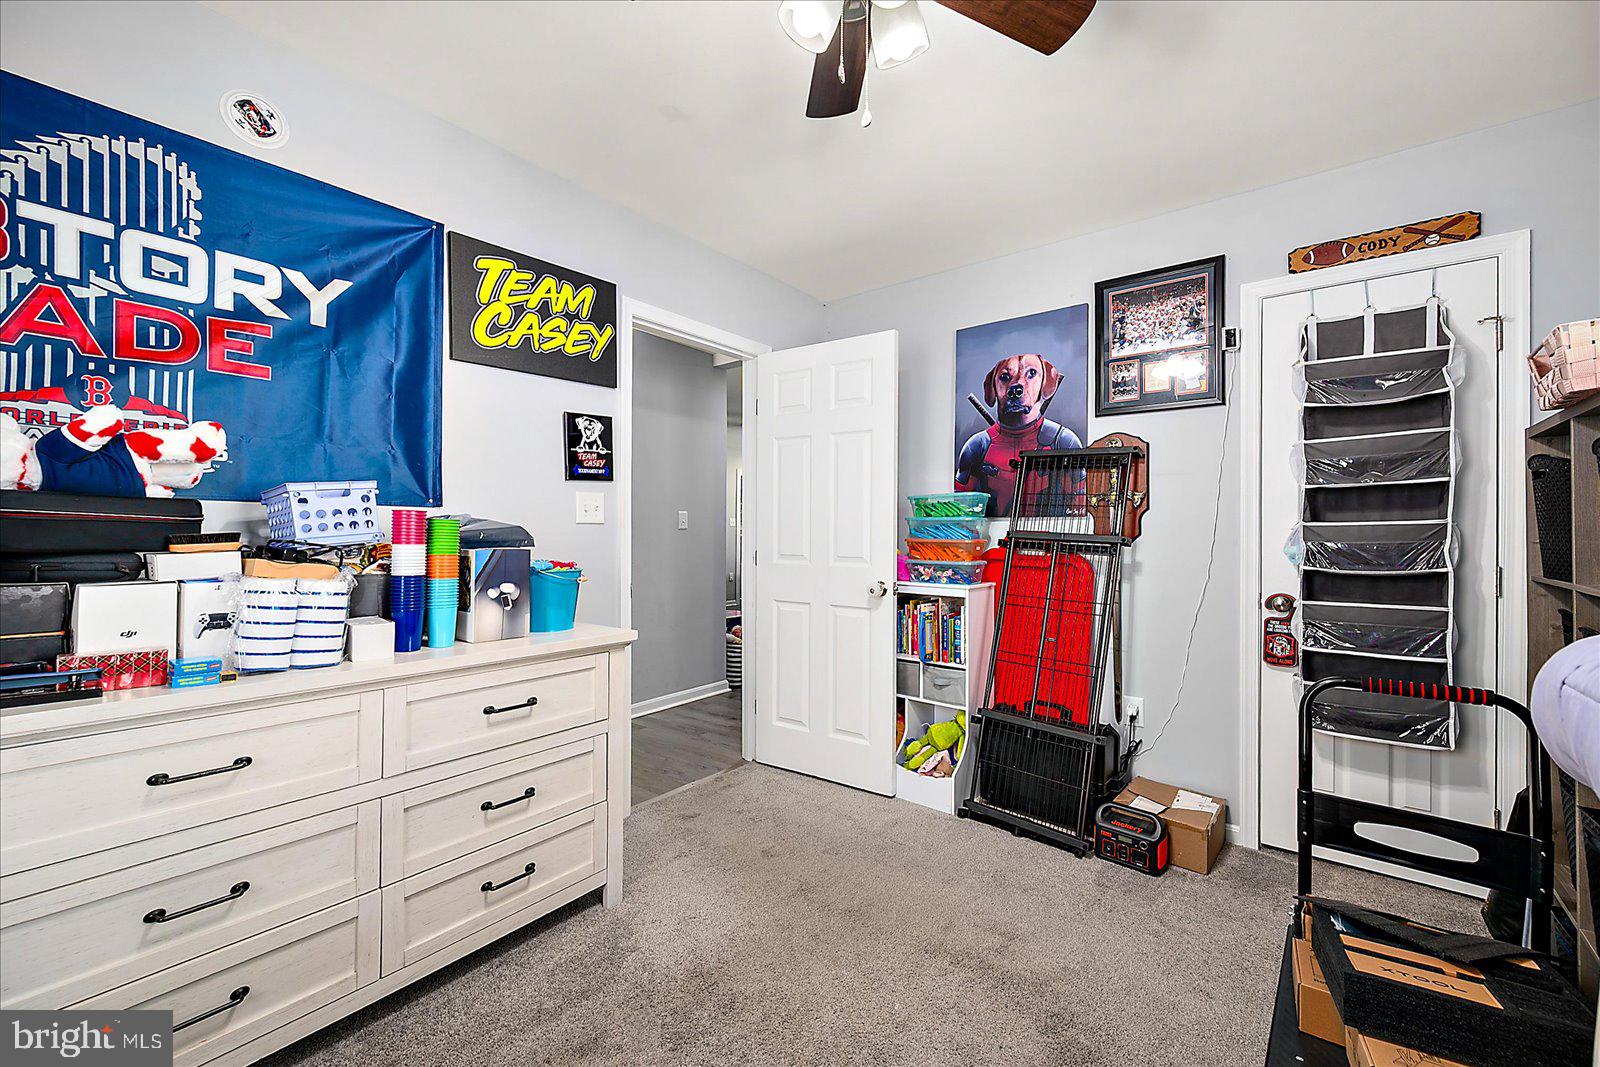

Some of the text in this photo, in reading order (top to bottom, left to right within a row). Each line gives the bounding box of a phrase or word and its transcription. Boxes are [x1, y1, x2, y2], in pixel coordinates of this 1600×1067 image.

[1358, 235, 1400, 254] CODY
[0, 197, 354, 328] TORY
[474, 256, 596, 320] TEAM
[472, 302, 615, 361] CASEY
[577, 452, 598, 461] TEAM
[583, 459, 607, 468] CASEY
[1110, 819, 1144, 834] Jackery
